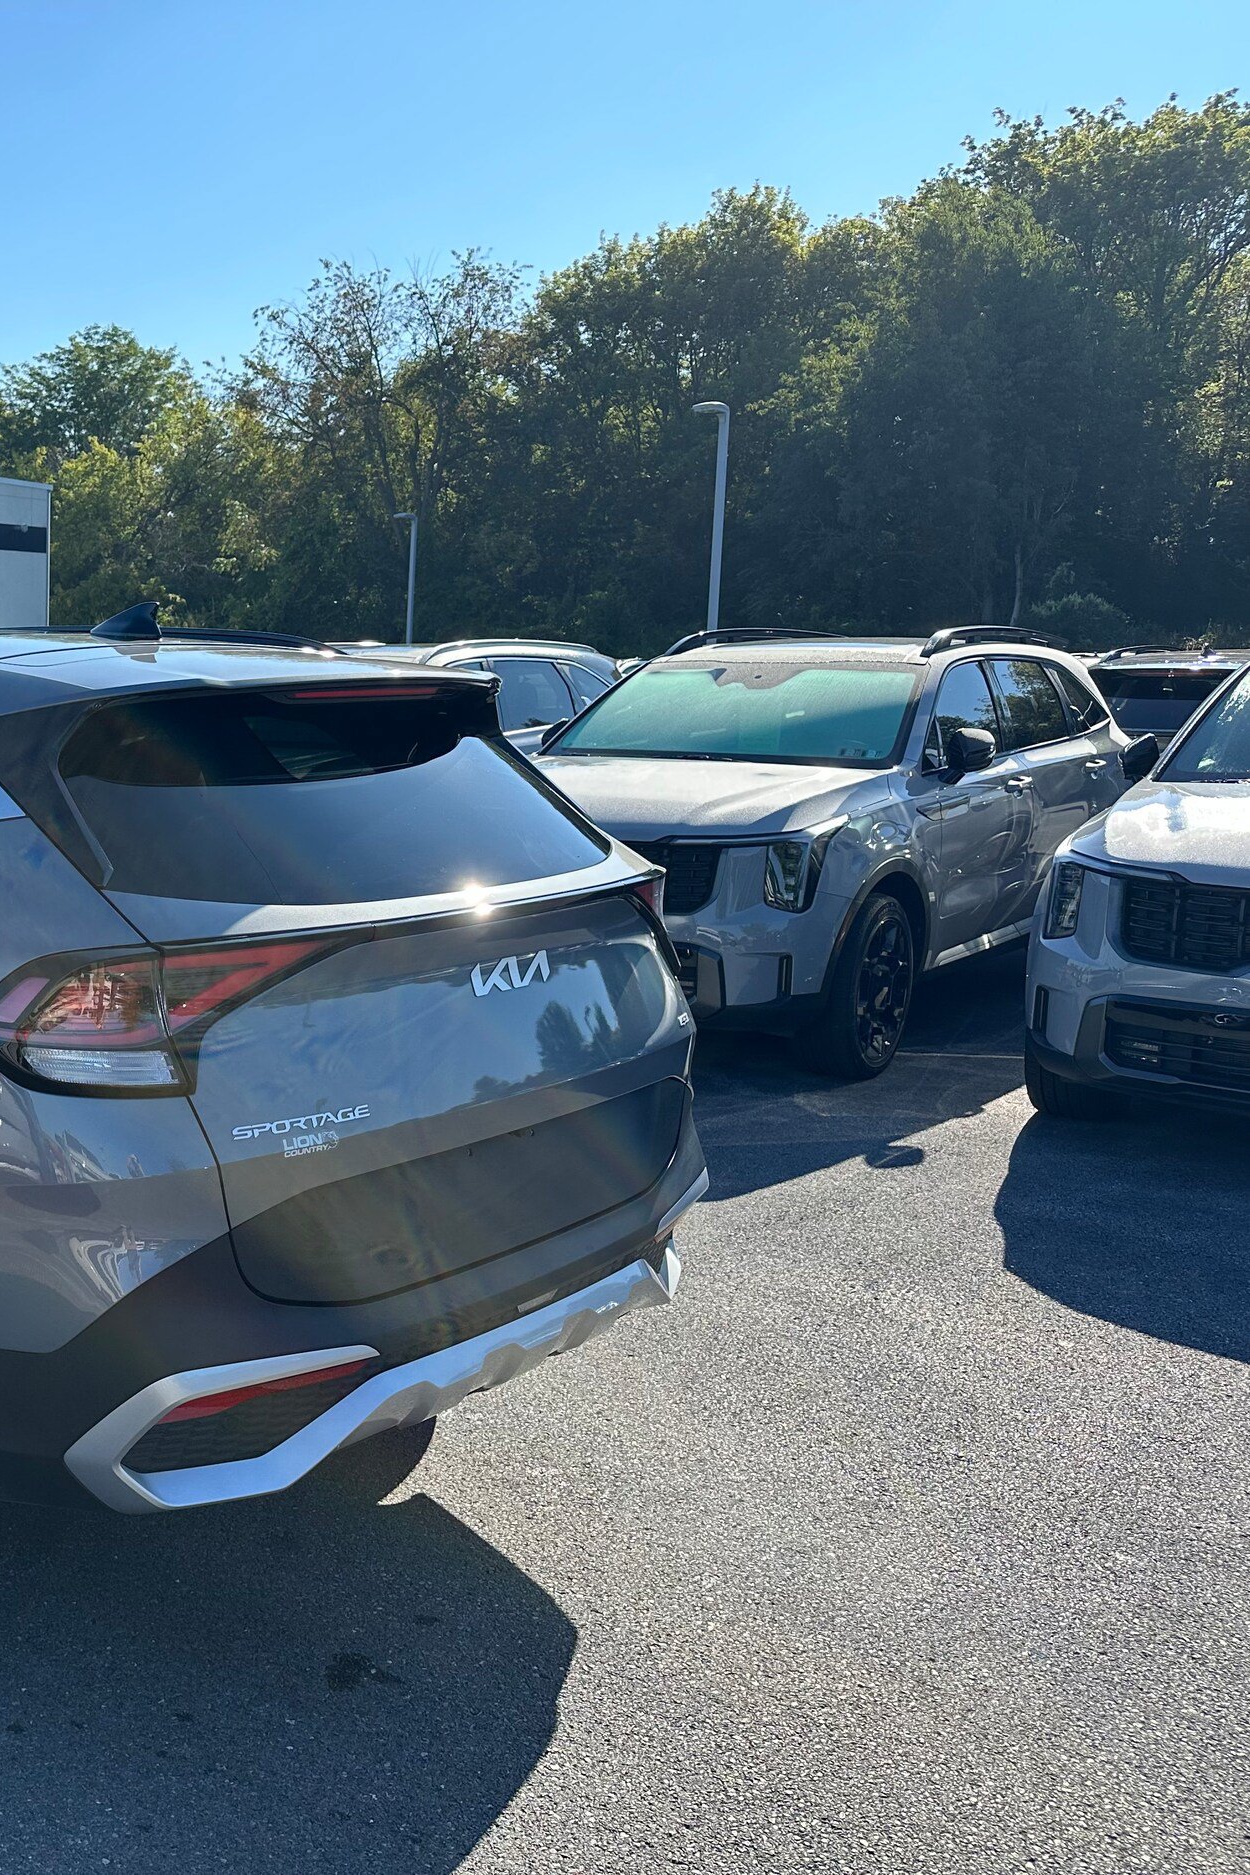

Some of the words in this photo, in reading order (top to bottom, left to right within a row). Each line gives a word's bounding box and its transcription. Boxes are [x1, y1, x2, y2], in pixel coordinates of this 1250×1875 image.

[470, 949, 550, 997] KIA
[231, 1104, 371, 1141] SPORTAGE
[282, 1132, 325, 1151] LION
[284, 1143, 330, 1158] COUNTRY
